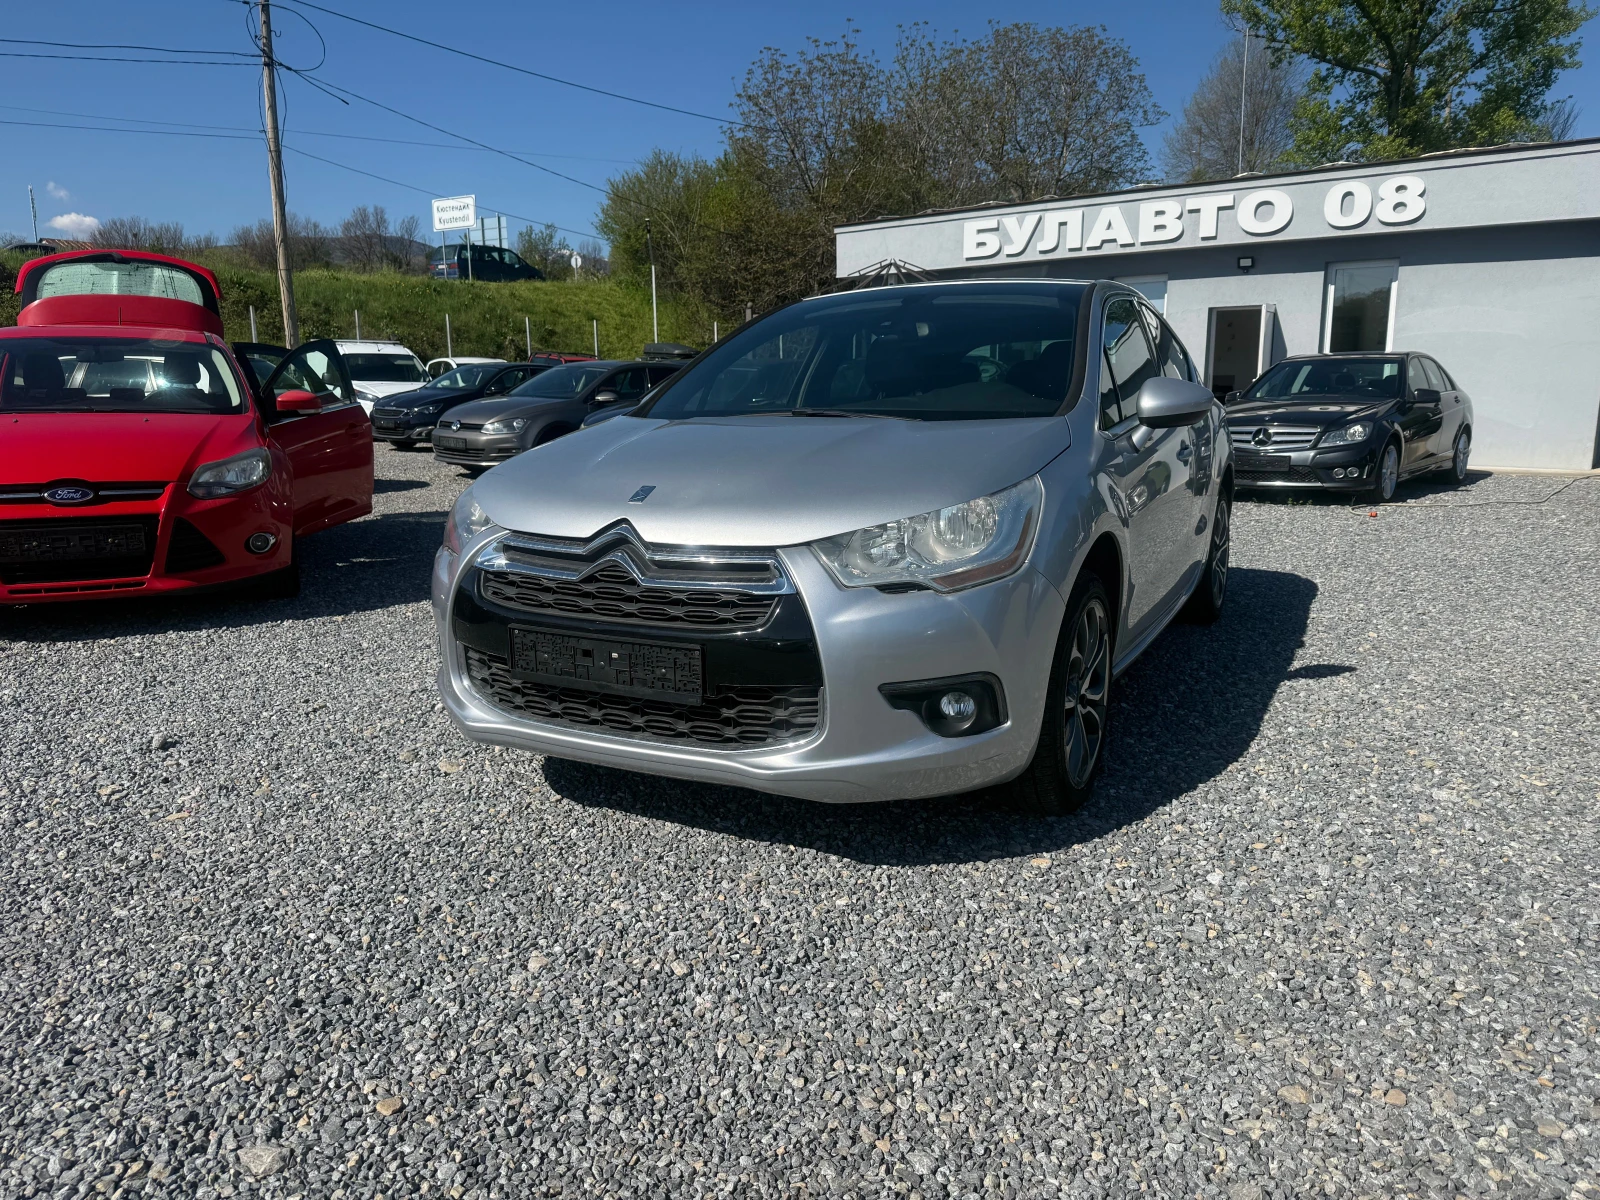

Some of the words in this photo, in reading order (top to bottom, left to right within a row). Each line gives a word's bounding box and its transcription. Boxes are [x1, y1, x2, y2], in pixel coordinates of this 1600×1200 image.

[436, 204, 470, 213] Кюстендил
[438, 214, 470, 226] Kyustendil
[963, 189, 1294, 260] БУЛАВТО
[1324, 176, 1426, 228] 08
[55, 489, 82, 499] Ford
